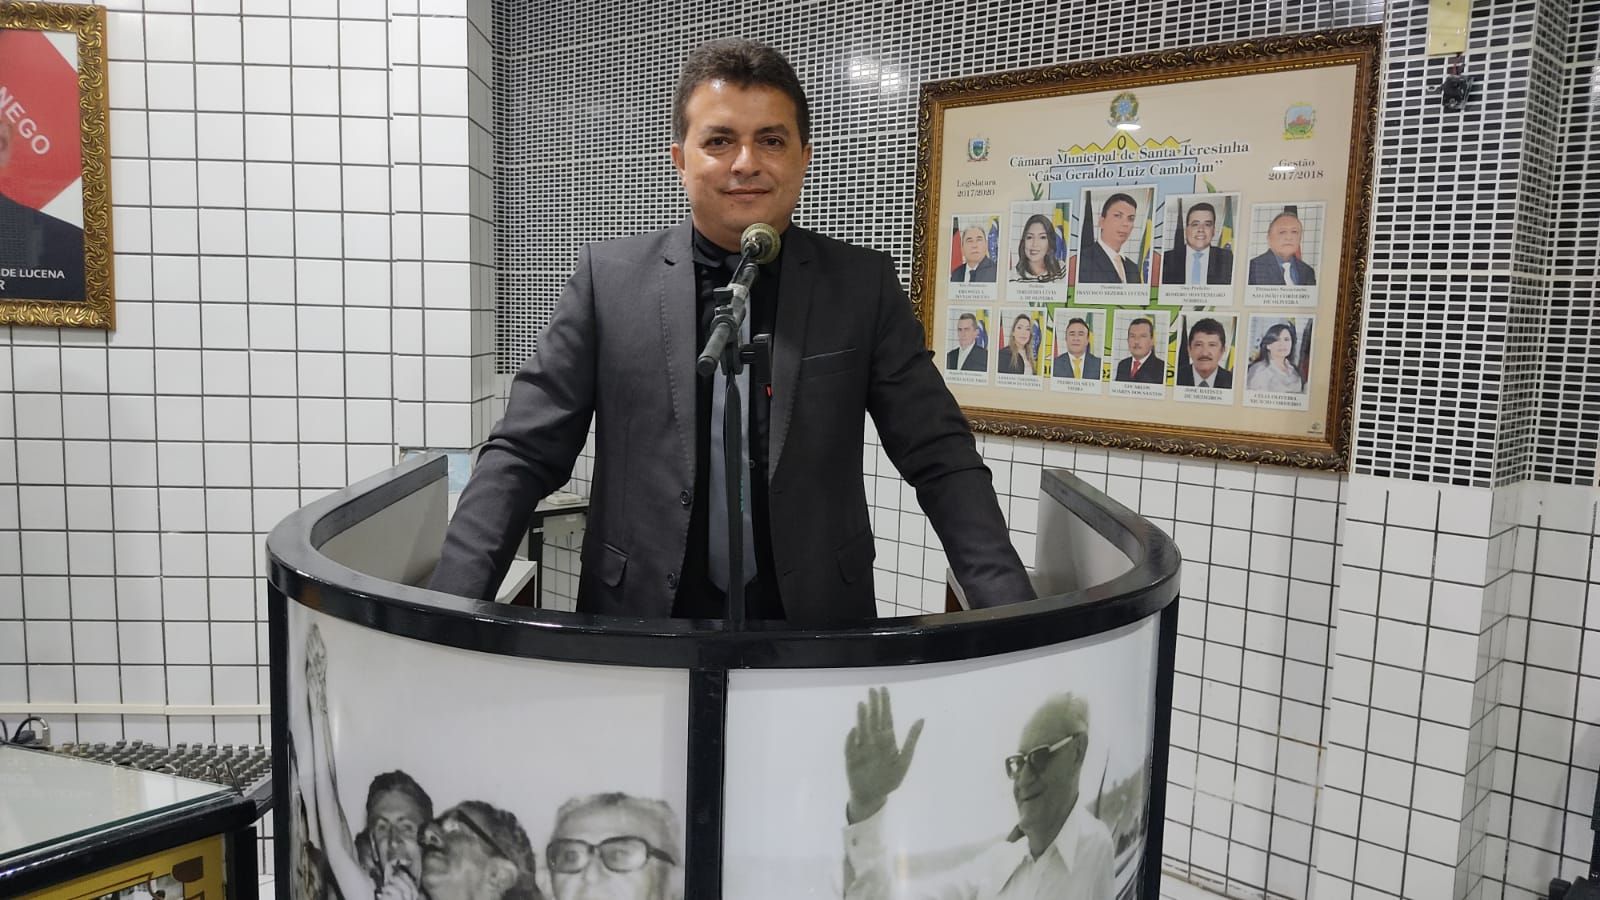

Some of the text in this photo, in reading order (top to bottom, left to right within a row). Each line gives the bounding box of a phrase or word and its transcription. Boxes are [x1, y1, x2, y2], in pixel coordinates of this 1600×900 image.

[1057, 150, 1116, 165] Municipal
[1120, 149, 1136, 160] de
[1139, 146, 1176, 159] Santa
[1181, 141, 1249, 156] Teresinha
[1278, 158, 1315, 169] Gestão
[1065, 168, 1114, 180] Geraldo
[1118, 166, 1145, 178] Luiz
[1268, 169, 1324, 181] 2017/2018
[956, 179, 997, 188] Legislatura
[1, 268, 65, 279] DE LUCENA
